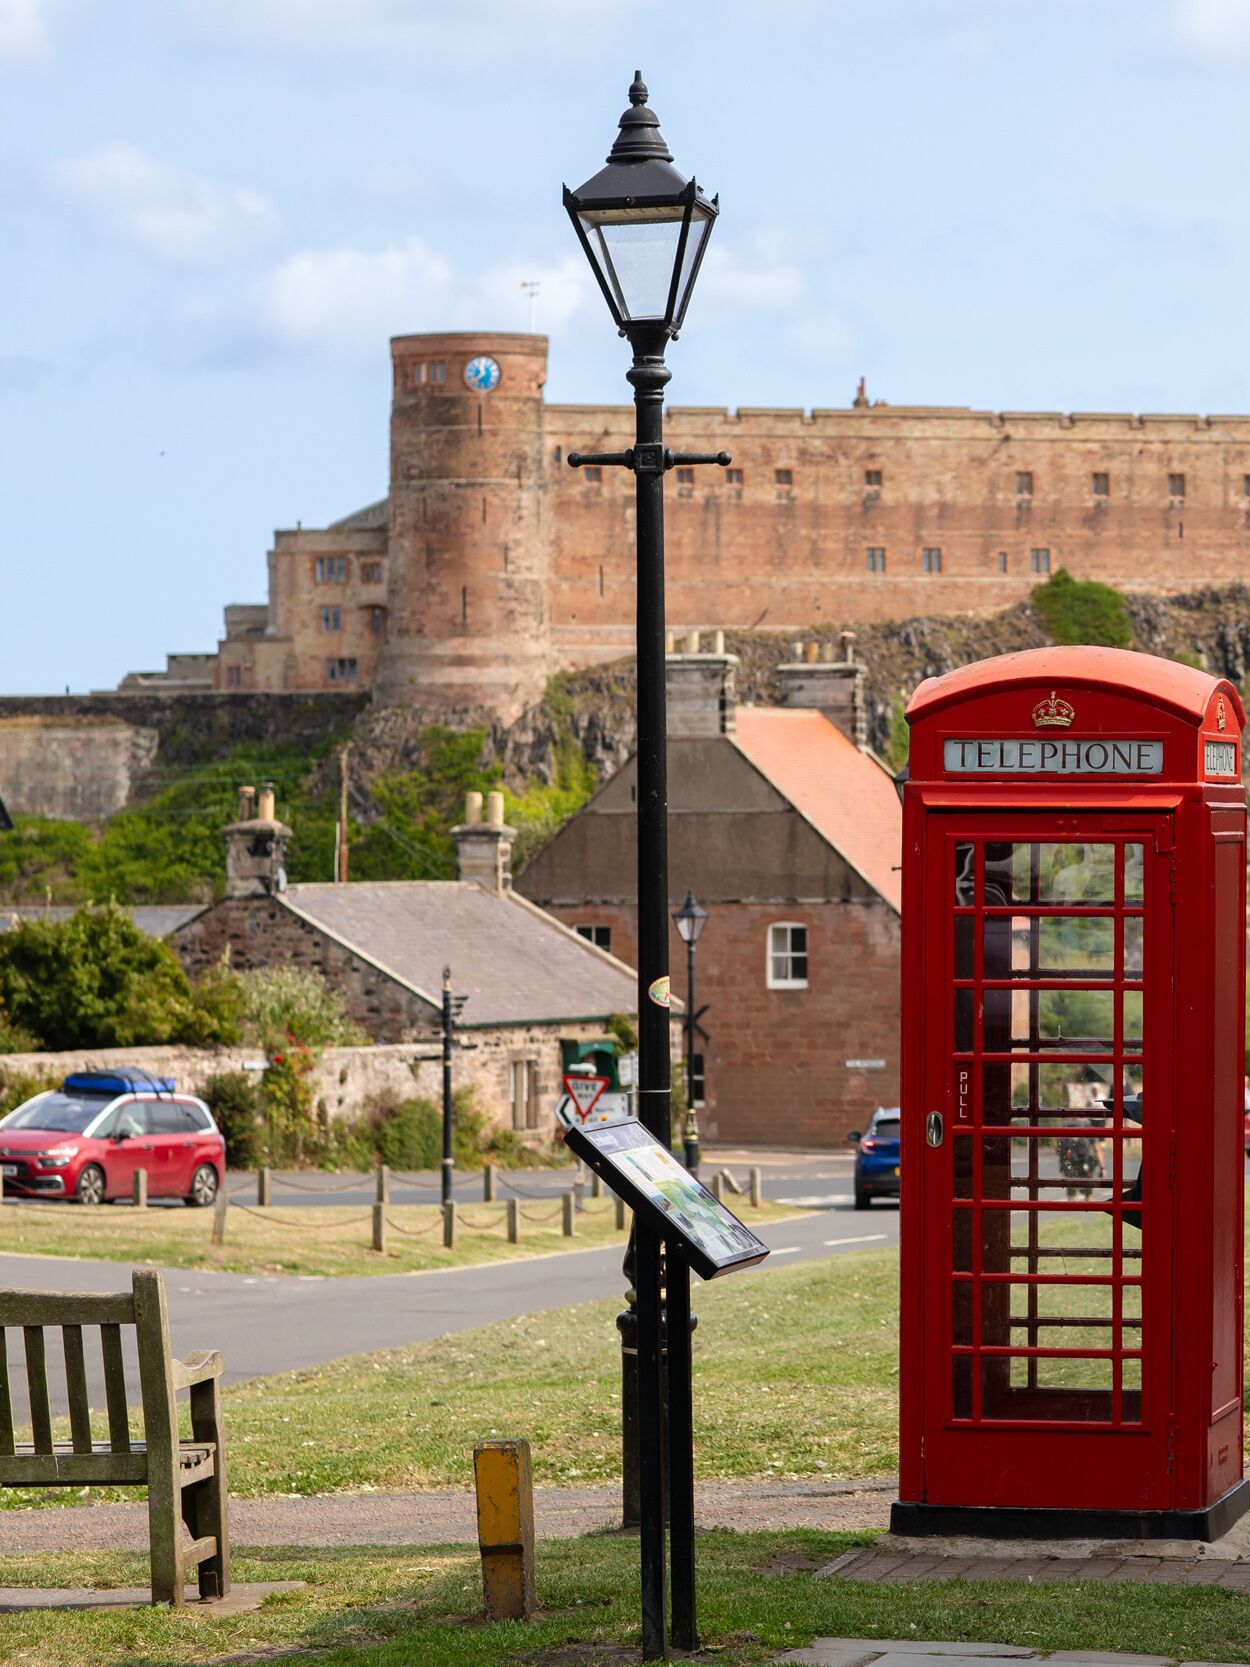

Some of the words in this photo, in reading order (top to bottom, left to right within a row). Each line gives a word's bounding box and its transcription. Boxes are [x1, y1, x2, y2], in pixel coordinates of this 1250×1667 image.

[953, 741, 1154, 770] TELEPHONE
[1204, 743, 1234, 772] ELEPHONE
[571, 1081, 597, 1090] GIVE
[959, 1071, 968, 1118] PULL
